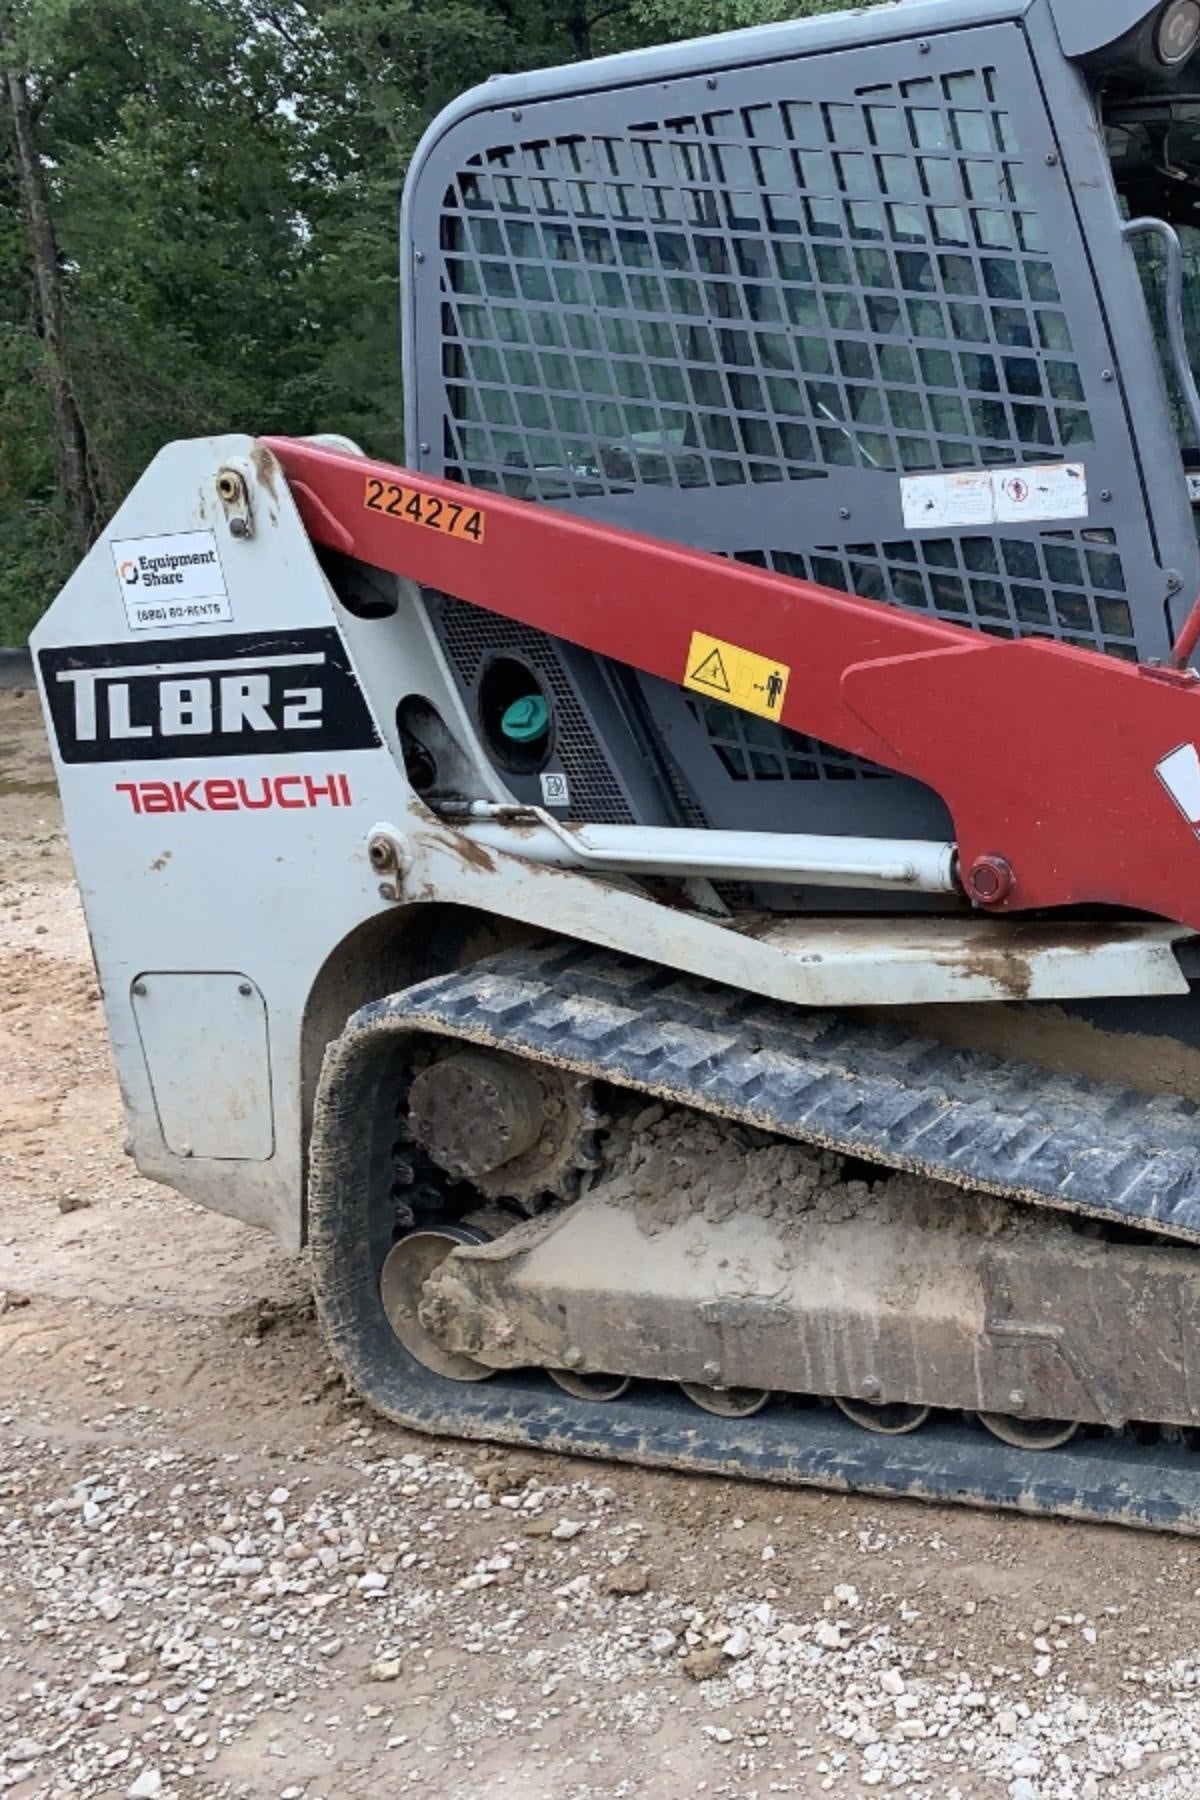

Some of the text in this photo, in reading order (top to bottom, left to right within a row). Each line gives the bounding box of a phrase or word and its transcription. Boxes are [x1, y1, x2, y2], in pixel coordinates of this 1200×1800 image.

[366, 479, 482, 541] 224274
[138, 550, 217, 573] Equipment
[141, 572, 184, 587] Share
[56, 651, 326, 742] TL8R2
